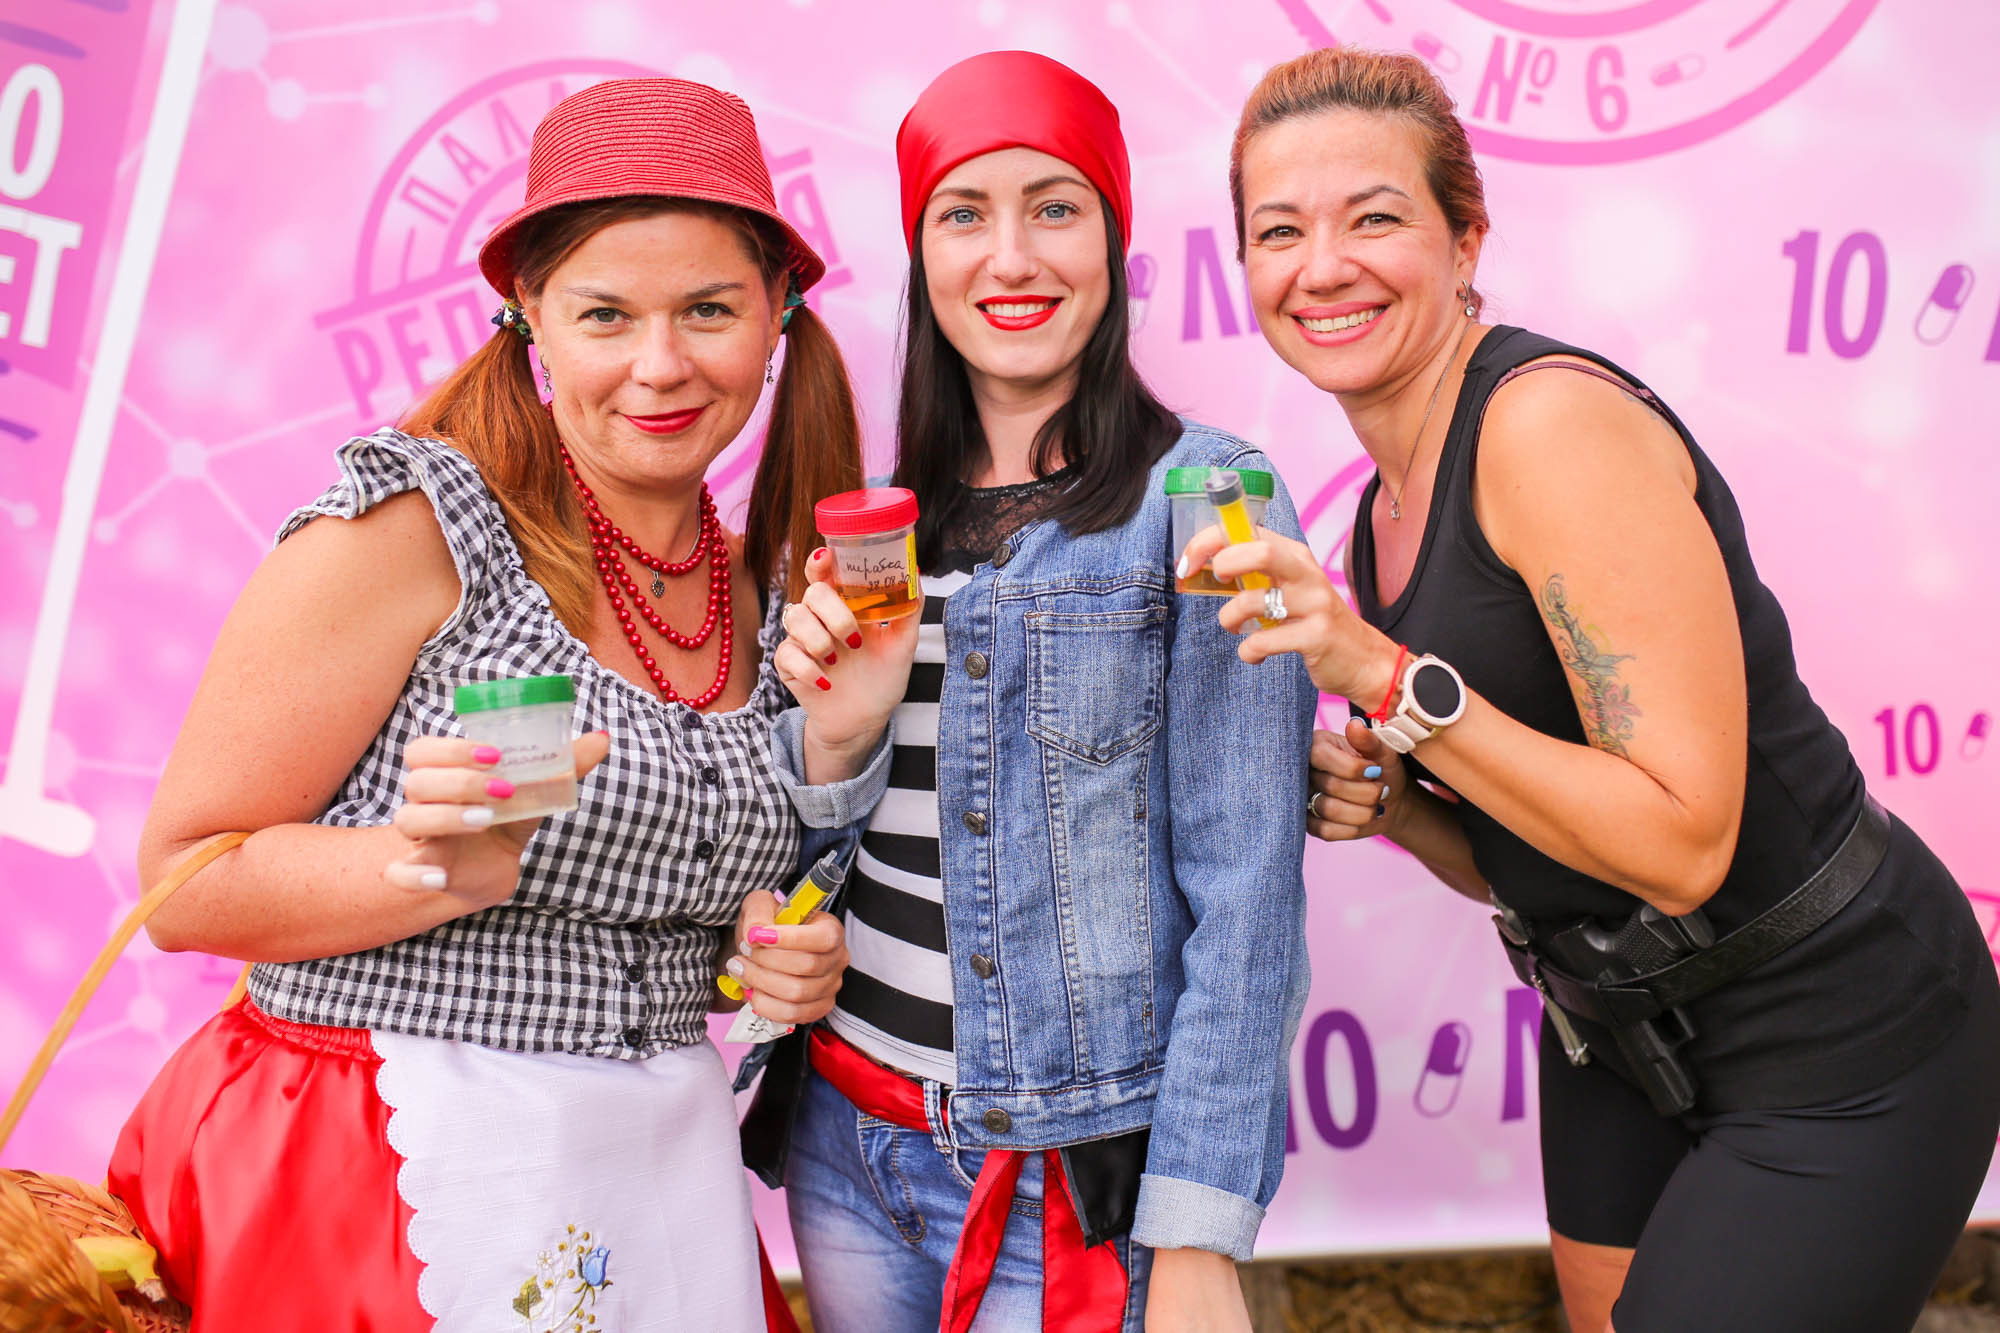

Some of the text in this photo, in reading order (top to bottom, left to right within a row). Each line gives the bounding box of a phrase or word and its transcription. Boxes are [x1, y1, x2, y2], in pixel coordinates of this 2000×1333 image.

[402, 80, 568, 225] ПАЛ
[1586, 45, 1629, 132] 6
[1782, 230, 1889, 359] 10
[1874, 703, 1941, 777] 10
[1285, 1009, 1378, 1152] 0
